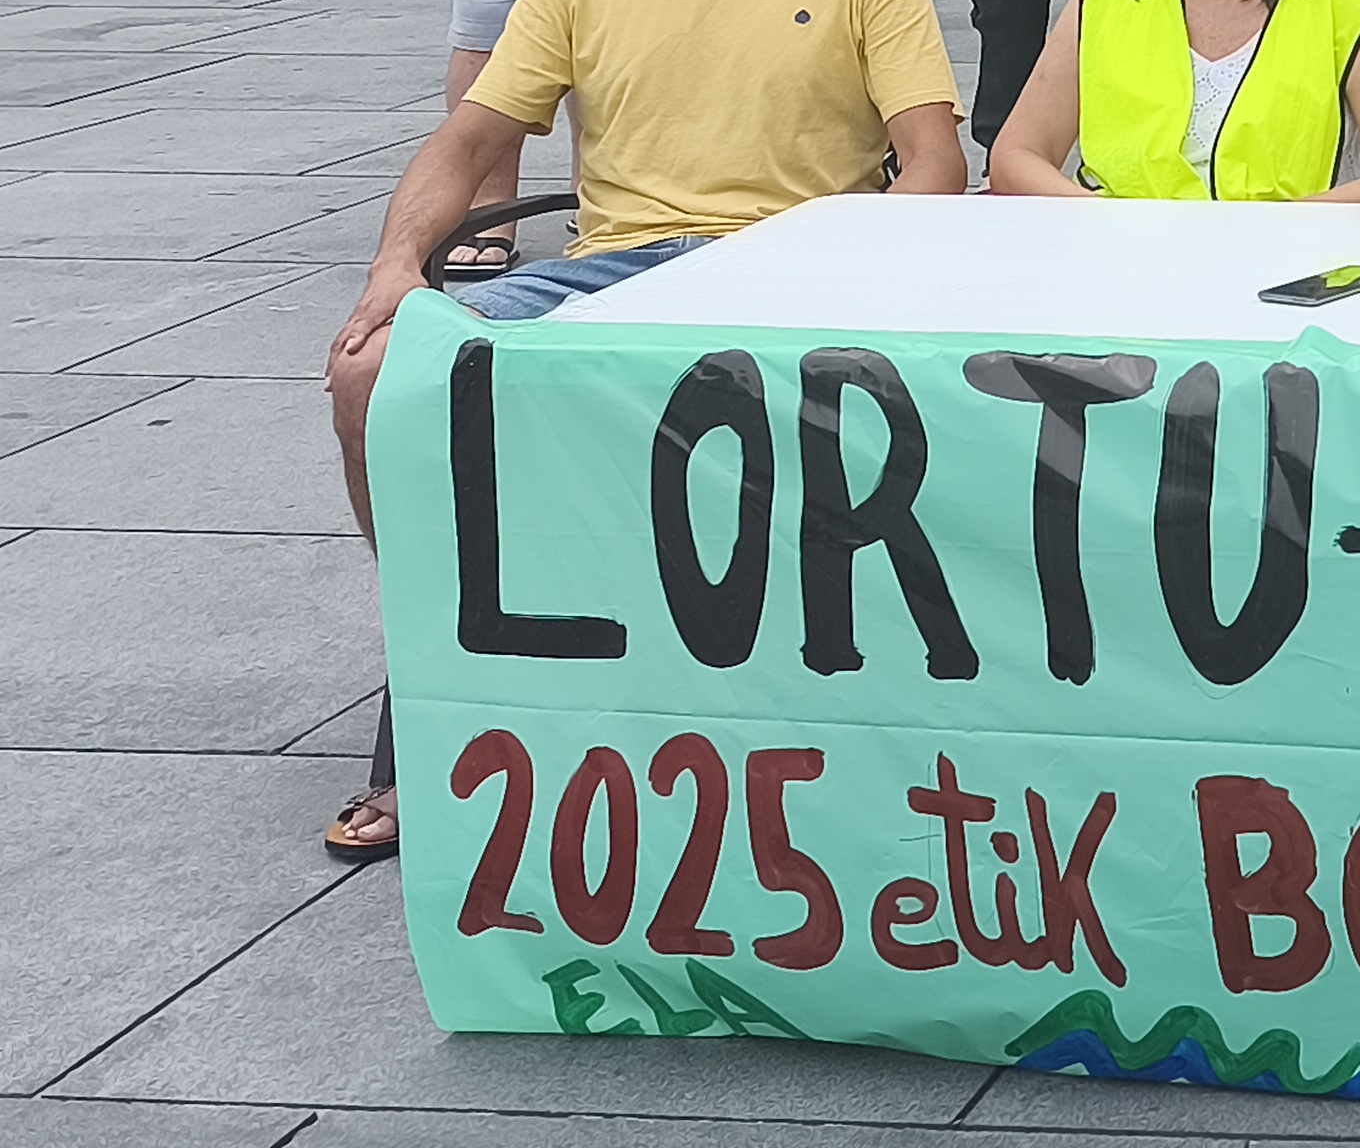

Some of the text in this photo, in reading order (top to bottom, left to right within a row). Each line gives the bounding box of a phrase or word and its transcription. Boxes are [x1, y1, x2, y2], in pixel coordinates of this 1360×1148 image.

[450, 338, 1320, 685] LORTU
[450, 728, 844, 970] 2025
[541, 957, 813, 1040] ELA
